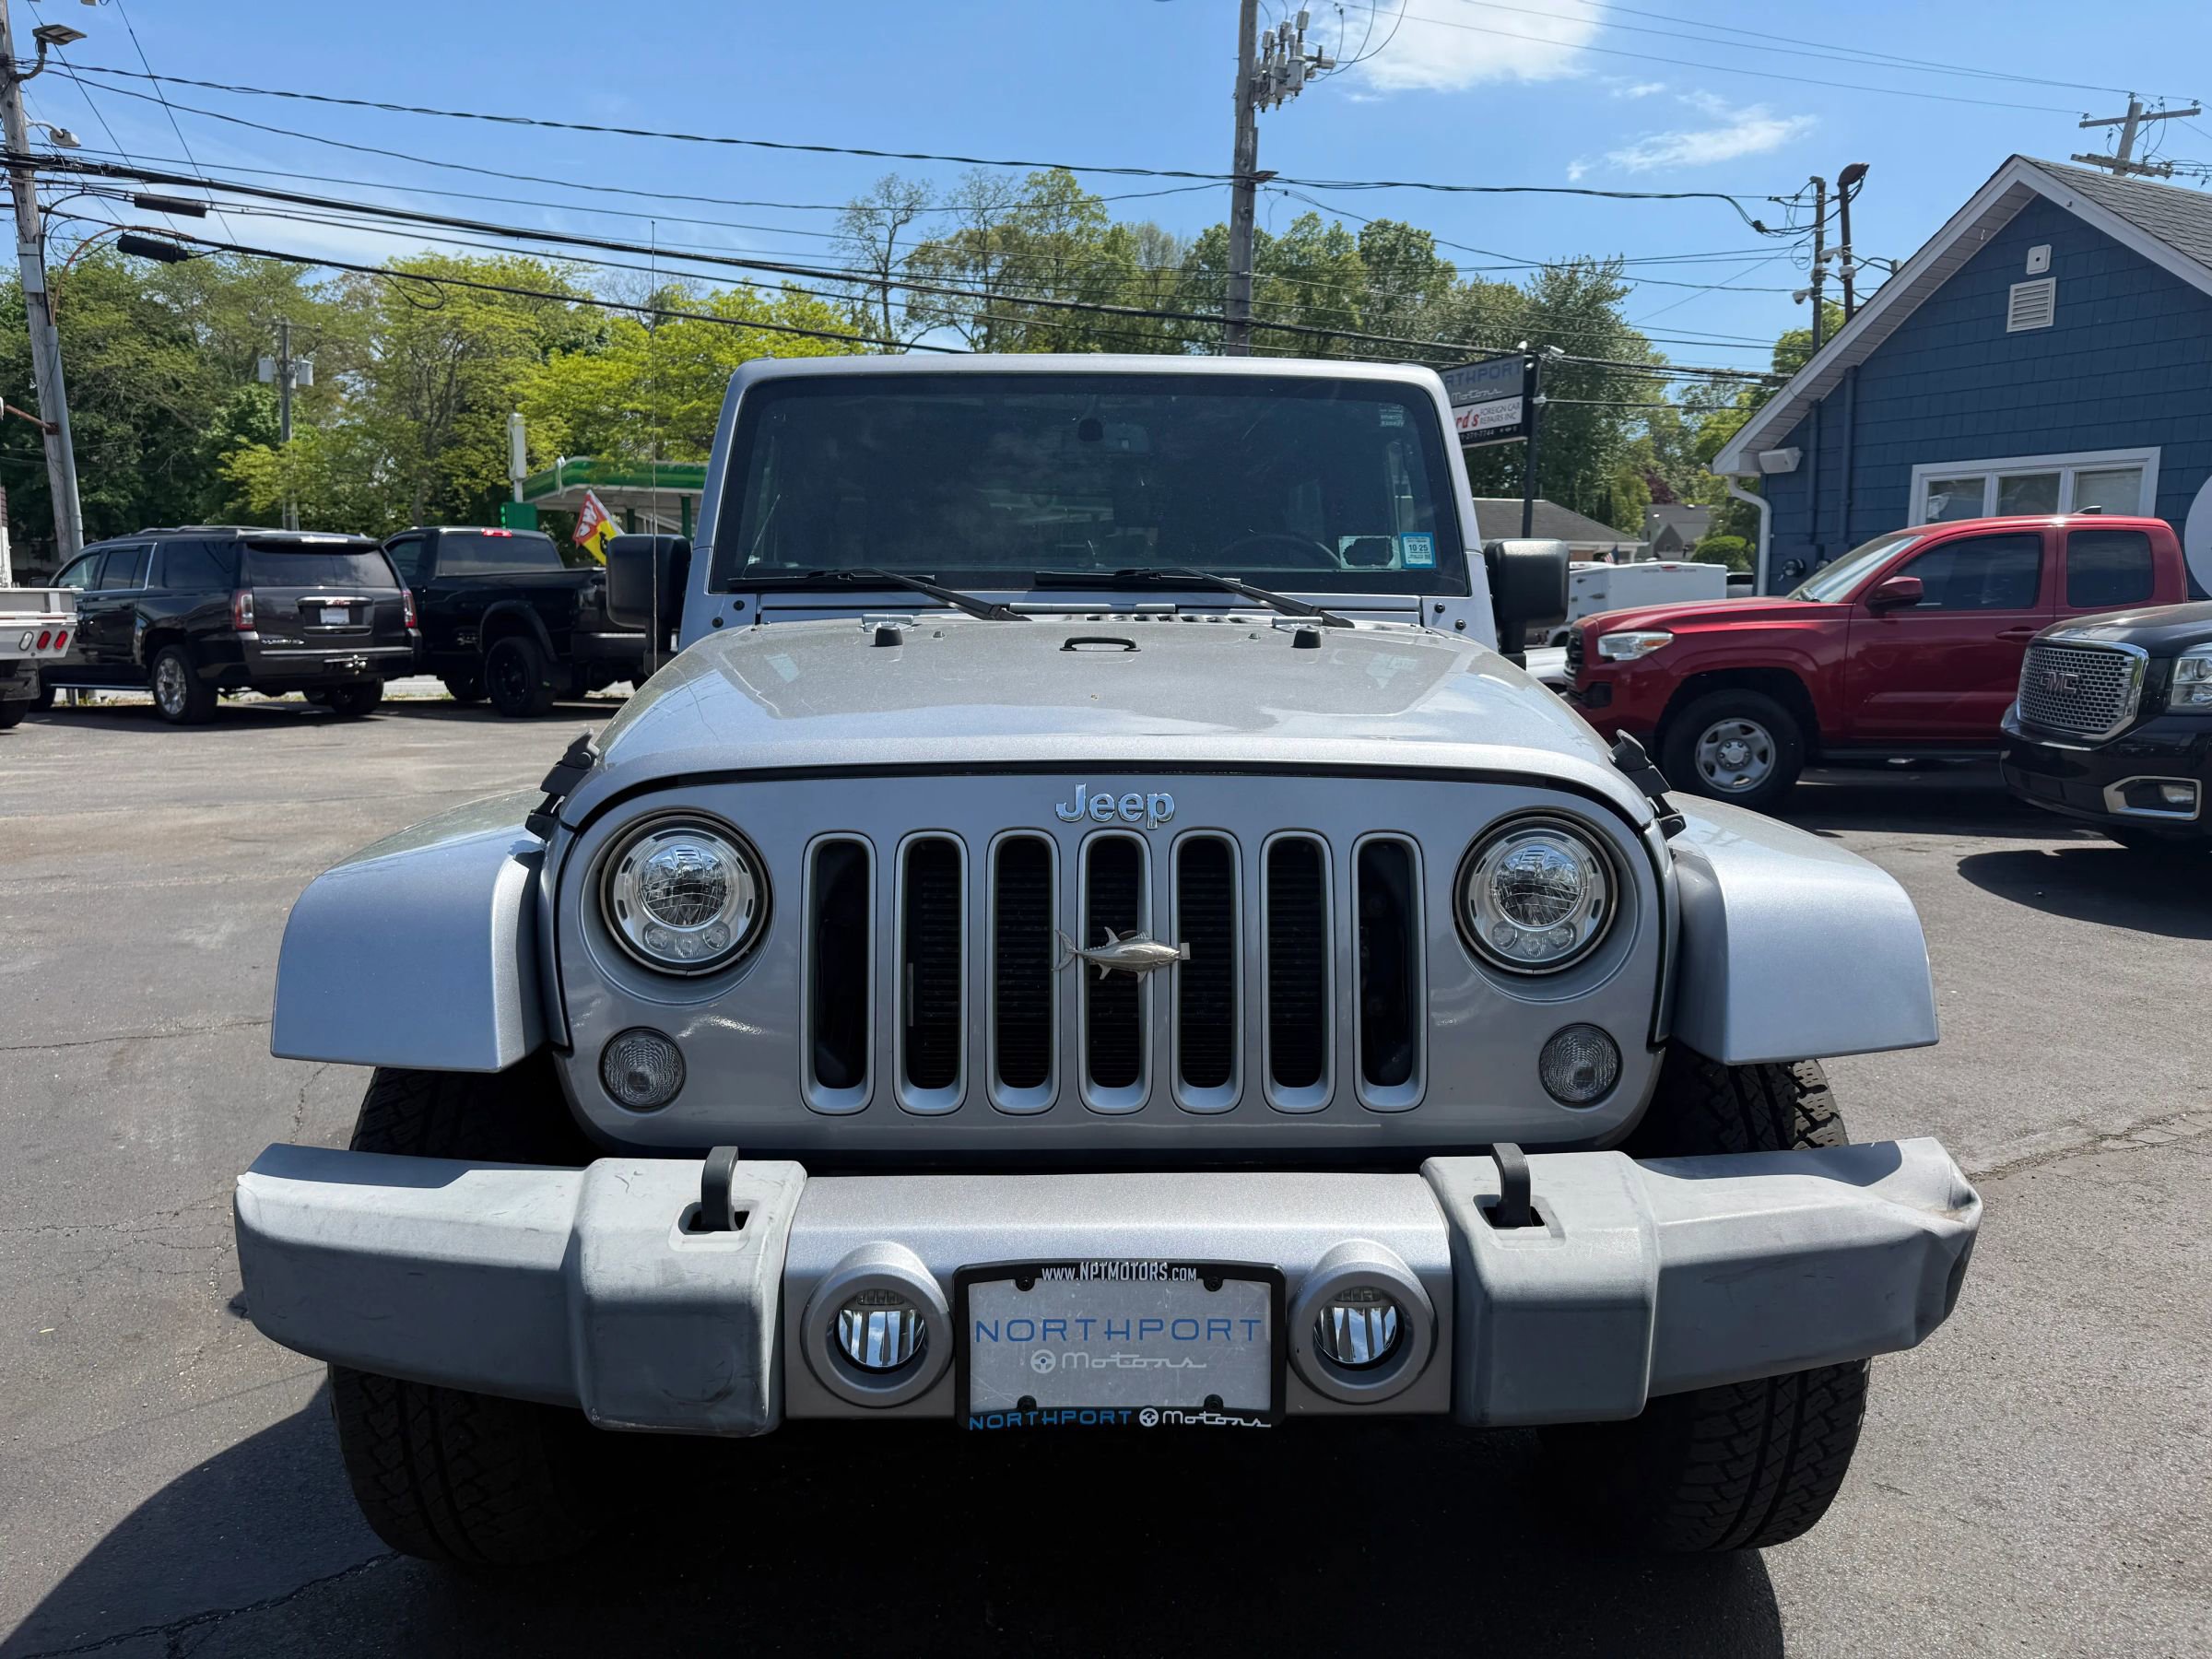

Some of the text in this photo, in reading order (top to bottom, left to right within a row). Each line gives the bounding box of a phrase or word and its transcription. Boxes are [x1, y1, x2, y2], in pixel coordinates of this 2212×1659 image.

[2040, 671, 2079, 693] GMC
[1055, 783, 1175, 830] Jeep
[975, 1318, 1262, 1342] NORTHPORT
[1062, 1351, 1206, 1369] Motors
[969, 1410, 1271, 1430] NORTHPORT Motors
